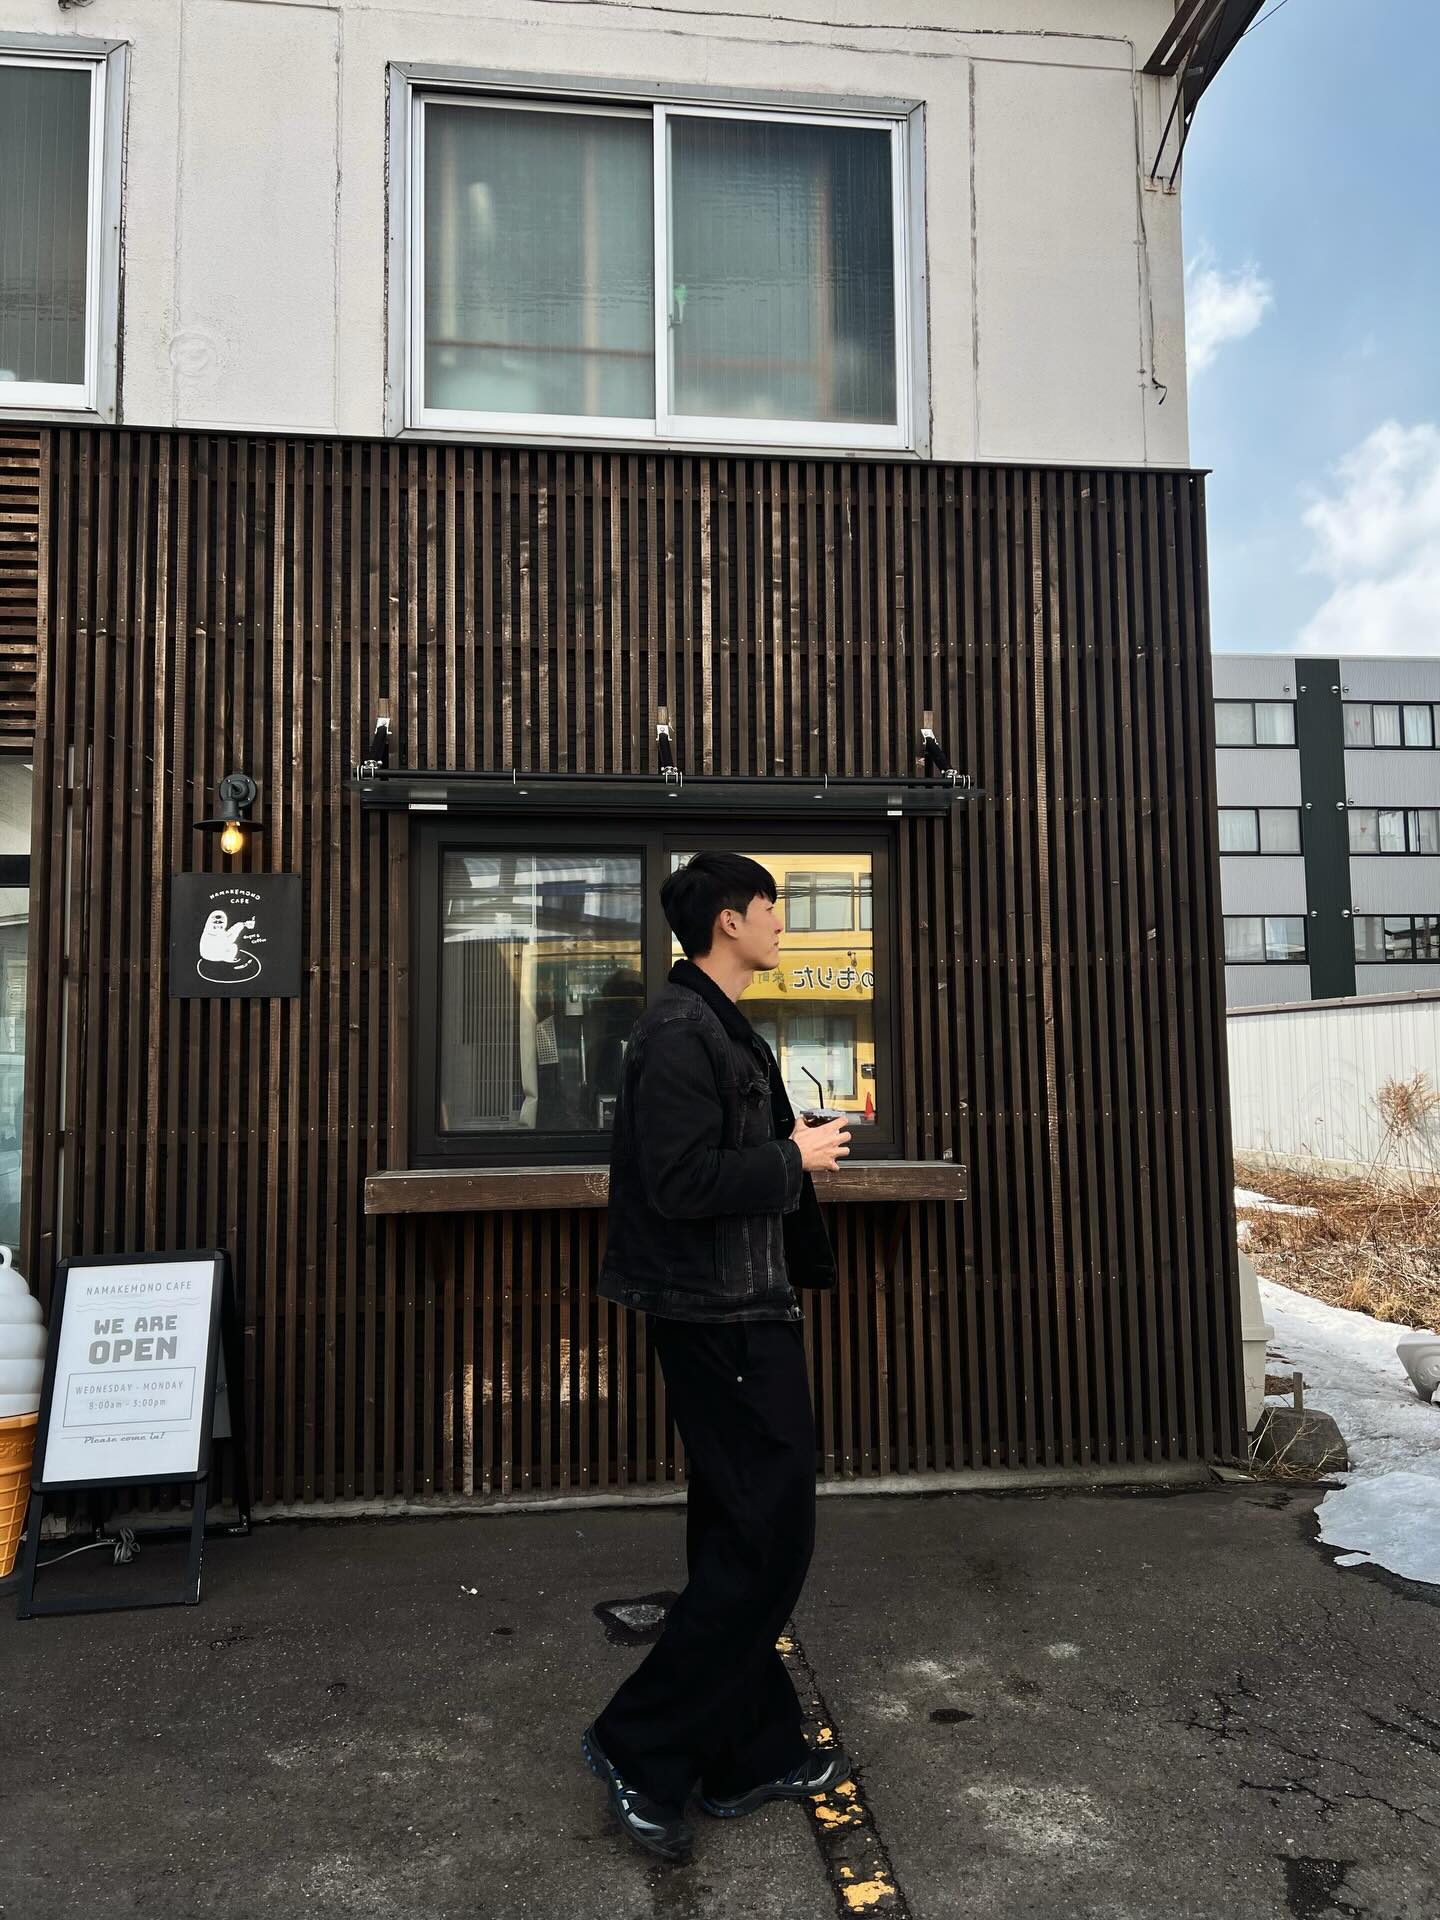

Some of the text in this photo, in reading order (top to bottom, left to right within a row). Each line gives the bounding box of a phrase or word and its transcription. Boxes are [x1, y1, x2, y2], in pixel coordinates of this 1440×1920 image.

[209, 889, 261, 900] NAMAKEMONO
[86, 1282, 162, 1296] NAMAKEMONO
[94, 1315, 178, 1335] WE ARE
[88, 1336, 178, 1365] OPEN
[75, 1383, 133, 1395] WEDNESDAY
[143, 1381, 184, 1391] MONDAY
[84, 1435, 117, 1444] Please
